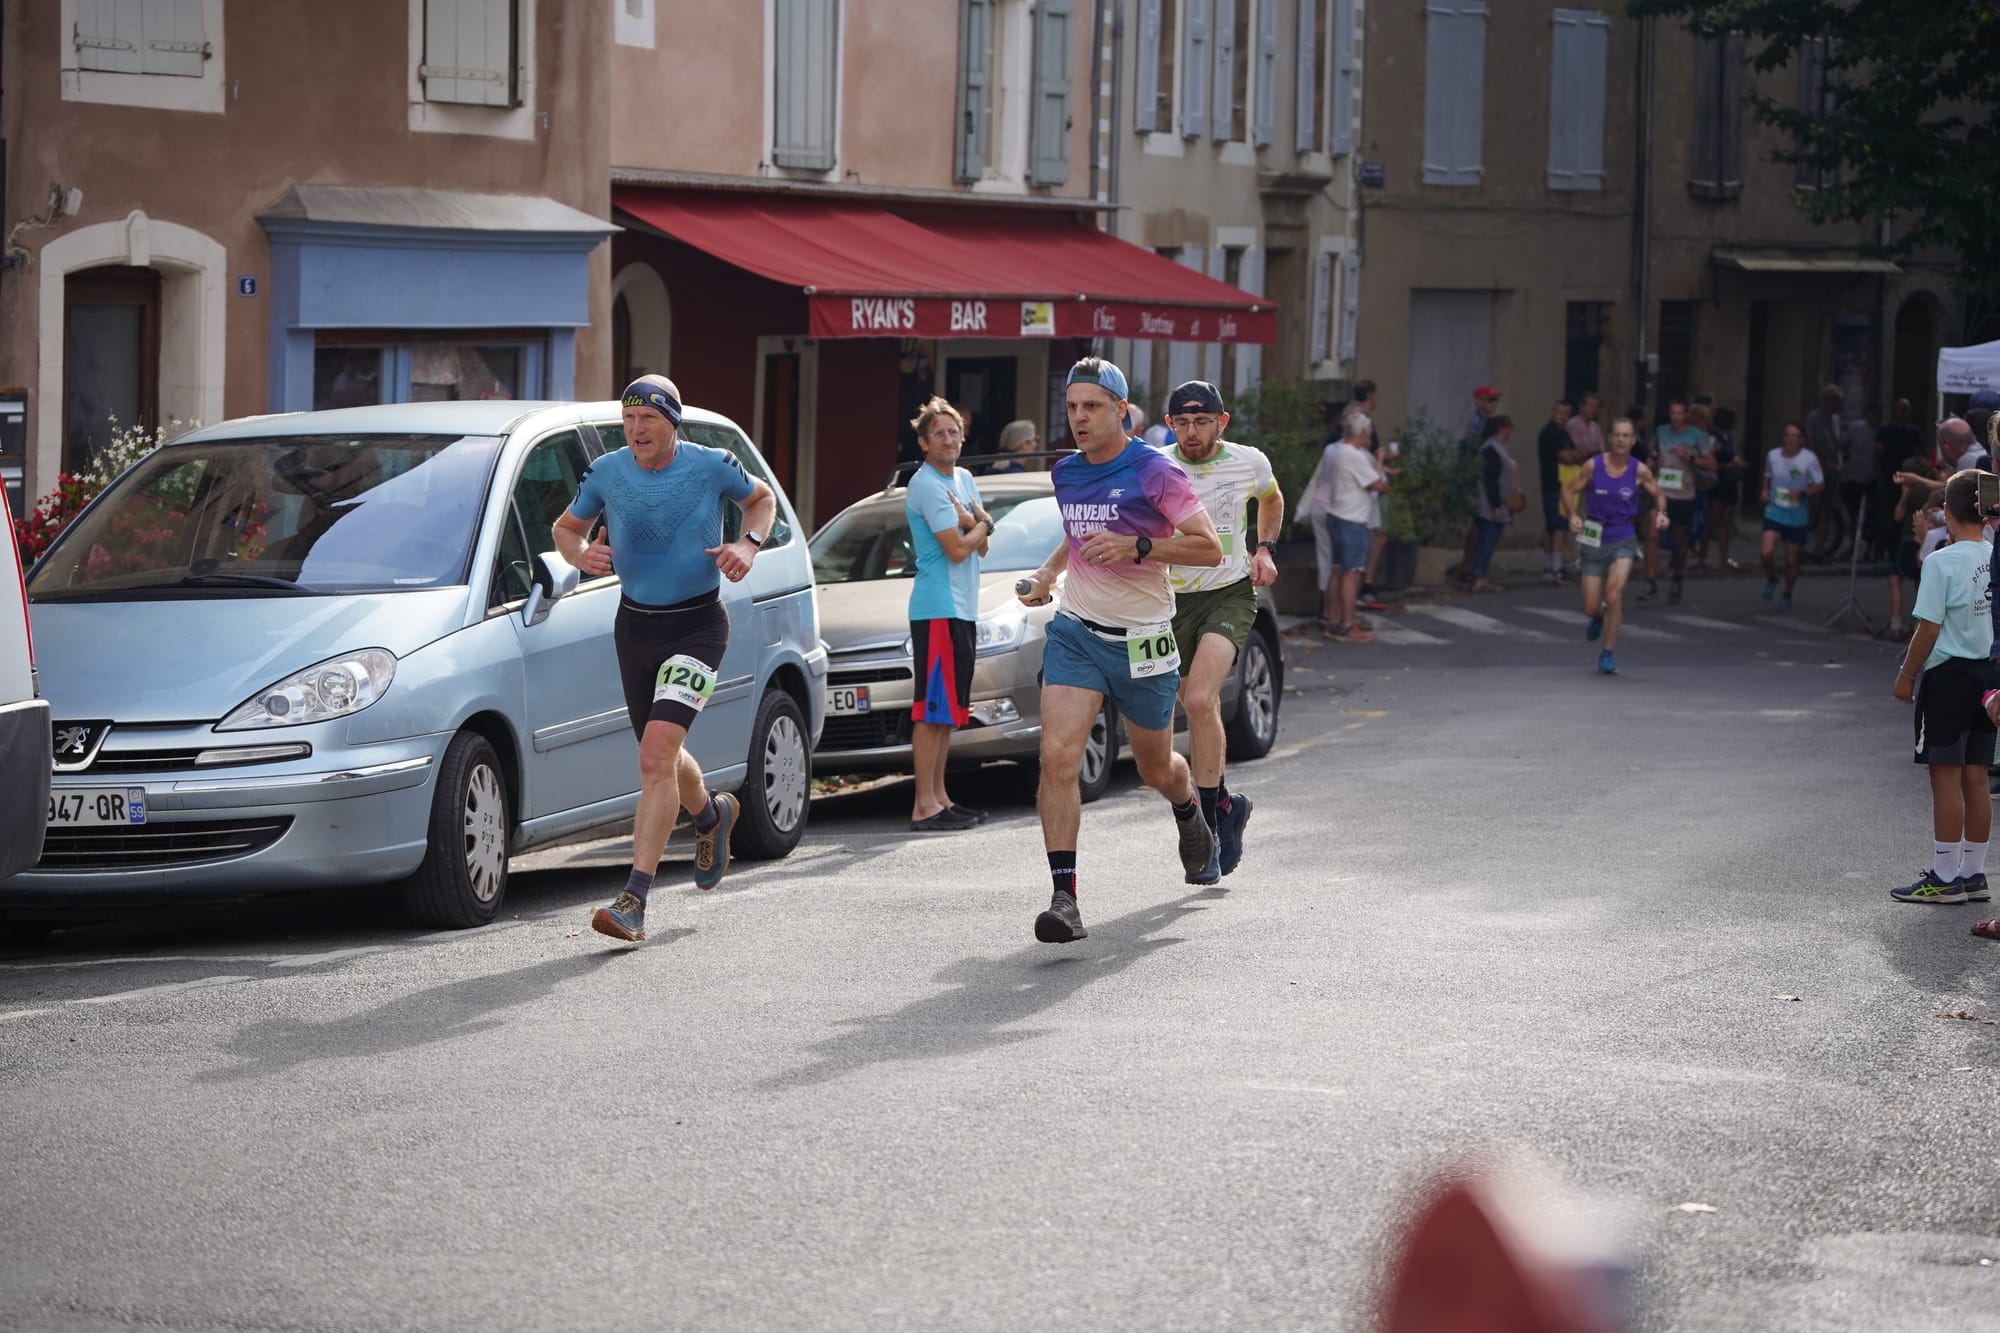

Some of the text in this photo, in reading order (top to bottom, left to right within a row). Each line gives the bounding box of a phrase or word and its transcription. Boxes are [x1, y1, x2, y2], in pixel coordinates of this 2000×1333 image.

[244, 279, 252, 294] 6
[851, 299, 916, 330] RYAN'S
[950, 301, 988, 331] BAR
[1092, 305, 1117, 331] Chez
[663, 665, 706, 692] 120
[130, 805, 144, 818] 59
